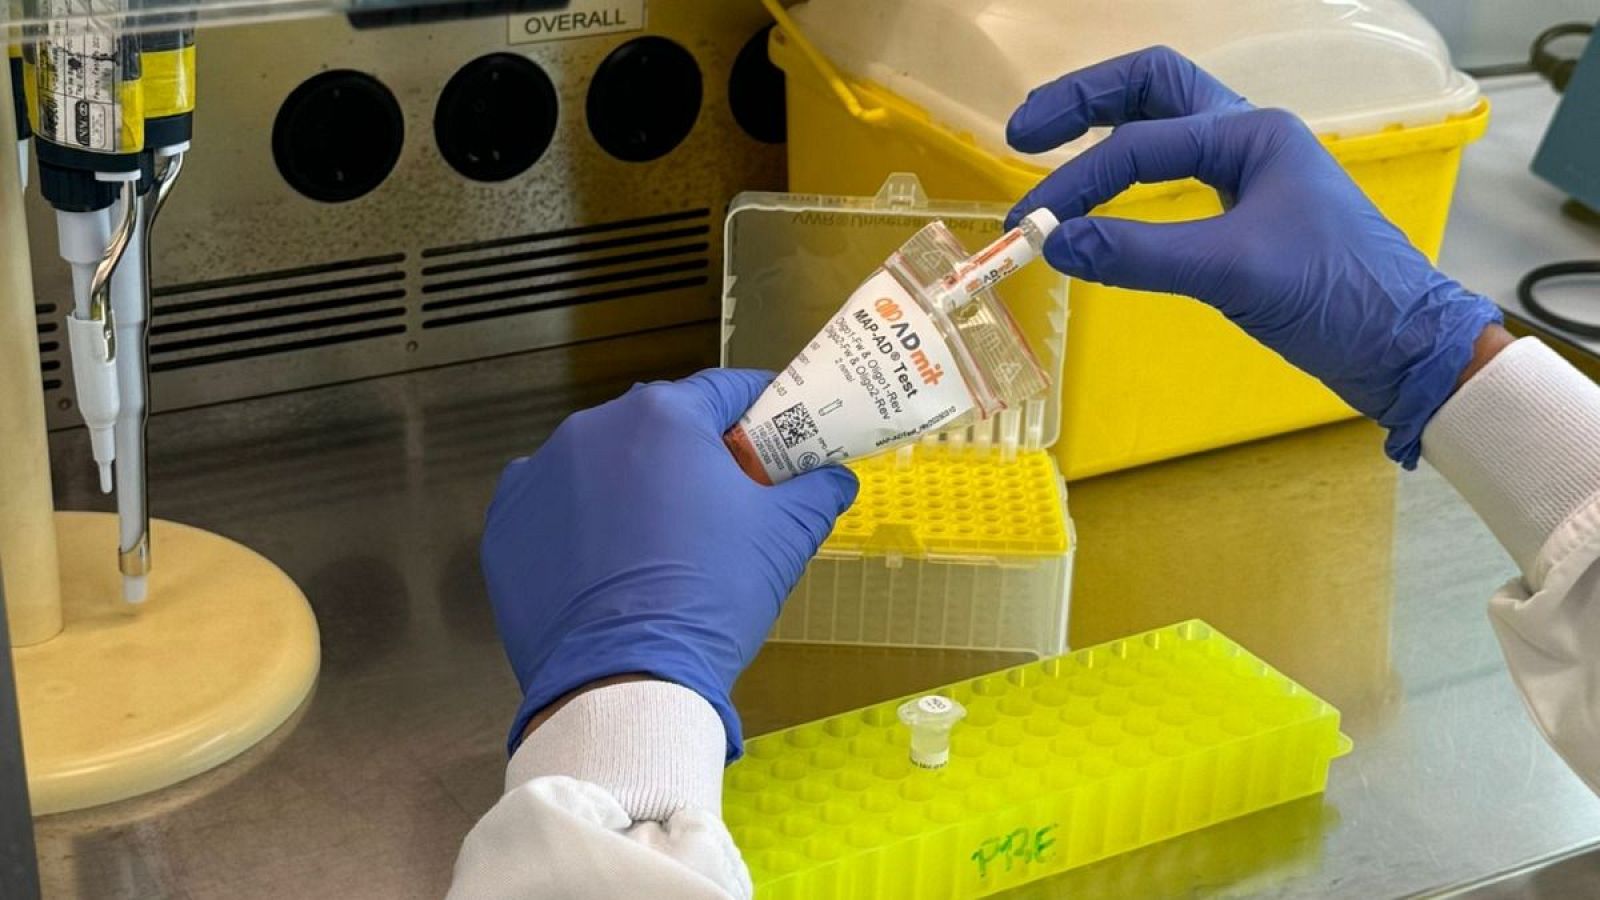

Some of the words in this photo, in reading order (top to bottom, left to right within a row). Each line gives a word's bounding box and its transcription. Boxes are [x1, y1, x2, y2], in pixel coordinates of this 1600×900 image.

[525, 8, 627, 35] OVERALL
[848, 356, 860, 366] &
[855, 365, 891, 420] Oligo2-Rev
[860, 350, 872, 360] &
[867, 358, 903, 414] Oligo1-Rev
[892, 361, 918, 399] Test
[970, 823, 1059, 878] PRE
